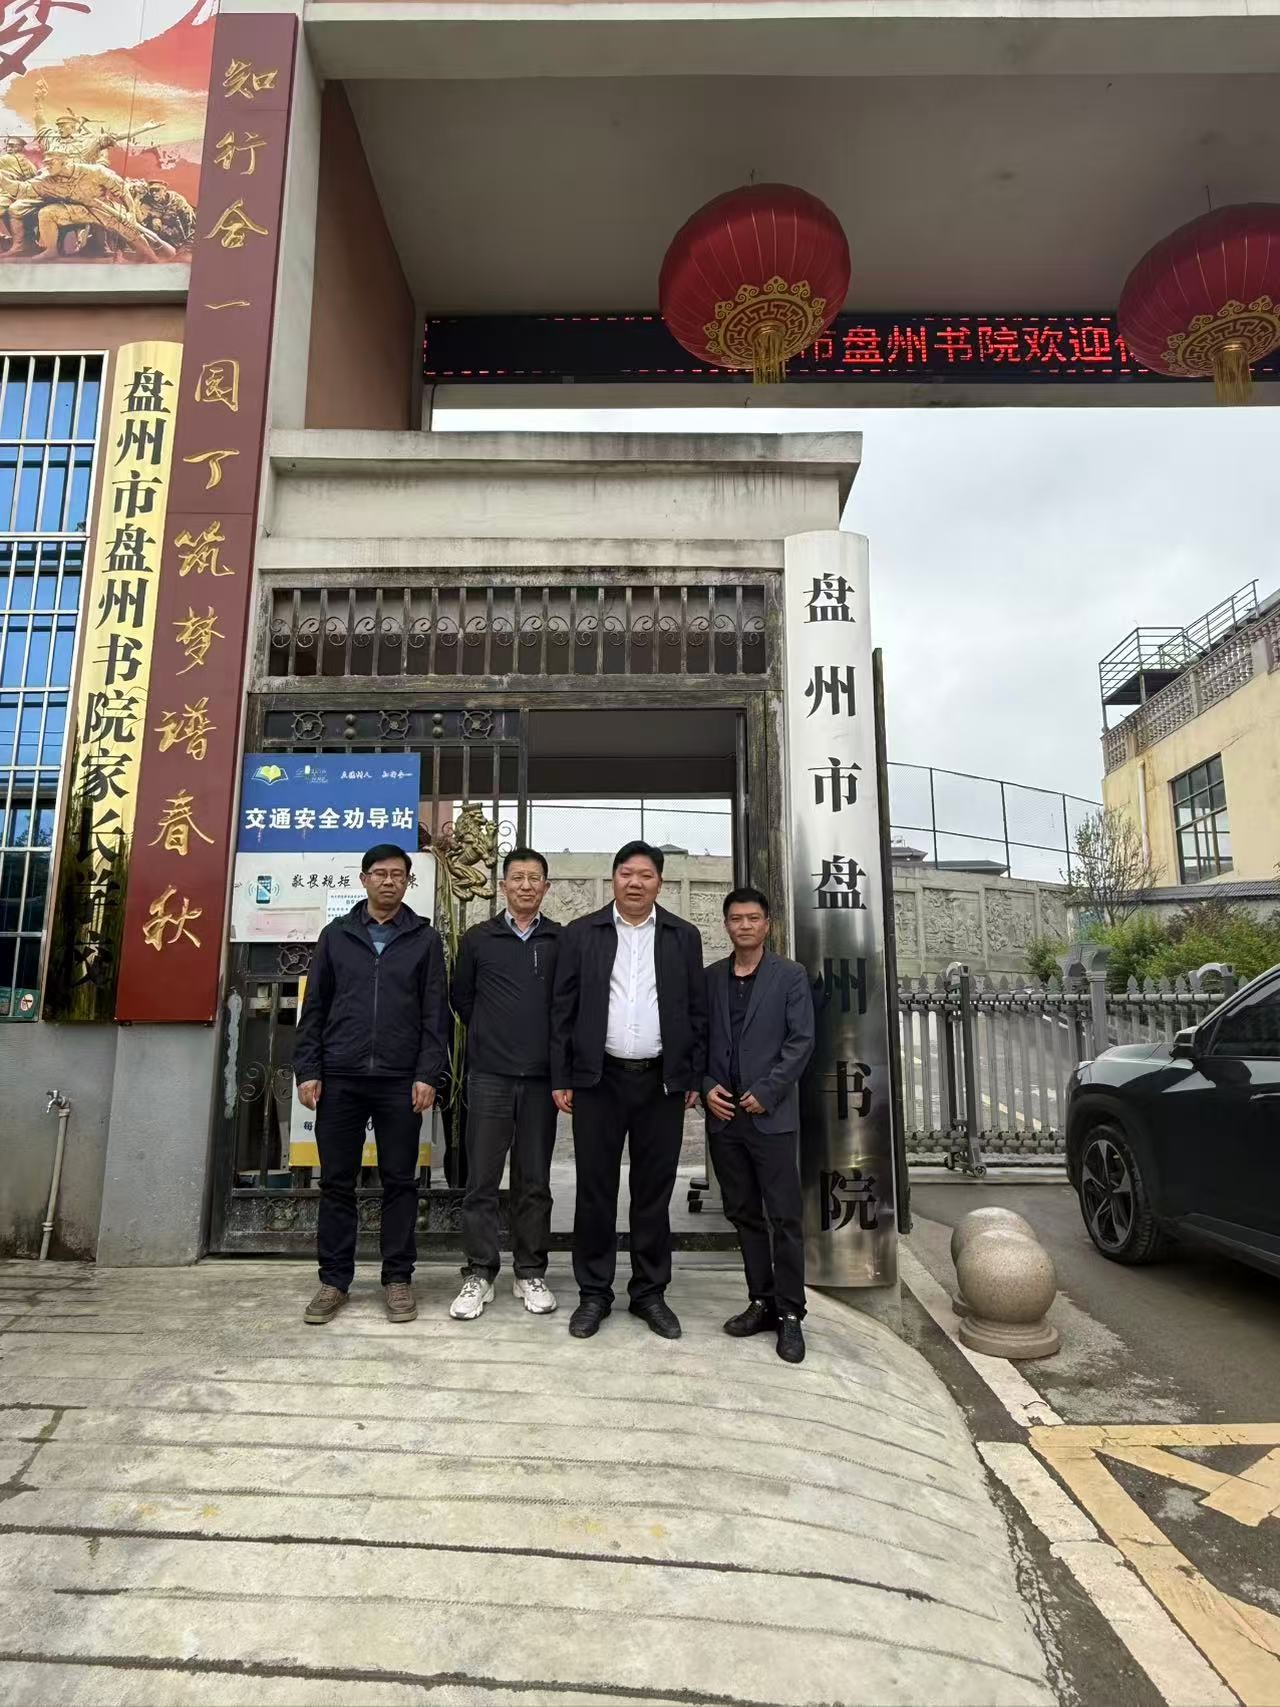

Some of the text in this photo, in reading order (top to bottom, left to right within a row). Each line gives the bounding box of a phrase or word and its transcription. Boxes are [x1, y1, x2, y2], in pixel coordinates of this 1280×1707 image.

[245, 807, 414, 829] 交通安全劝导站
[803, 572, 879, 1232] 盘州市盘州书院
